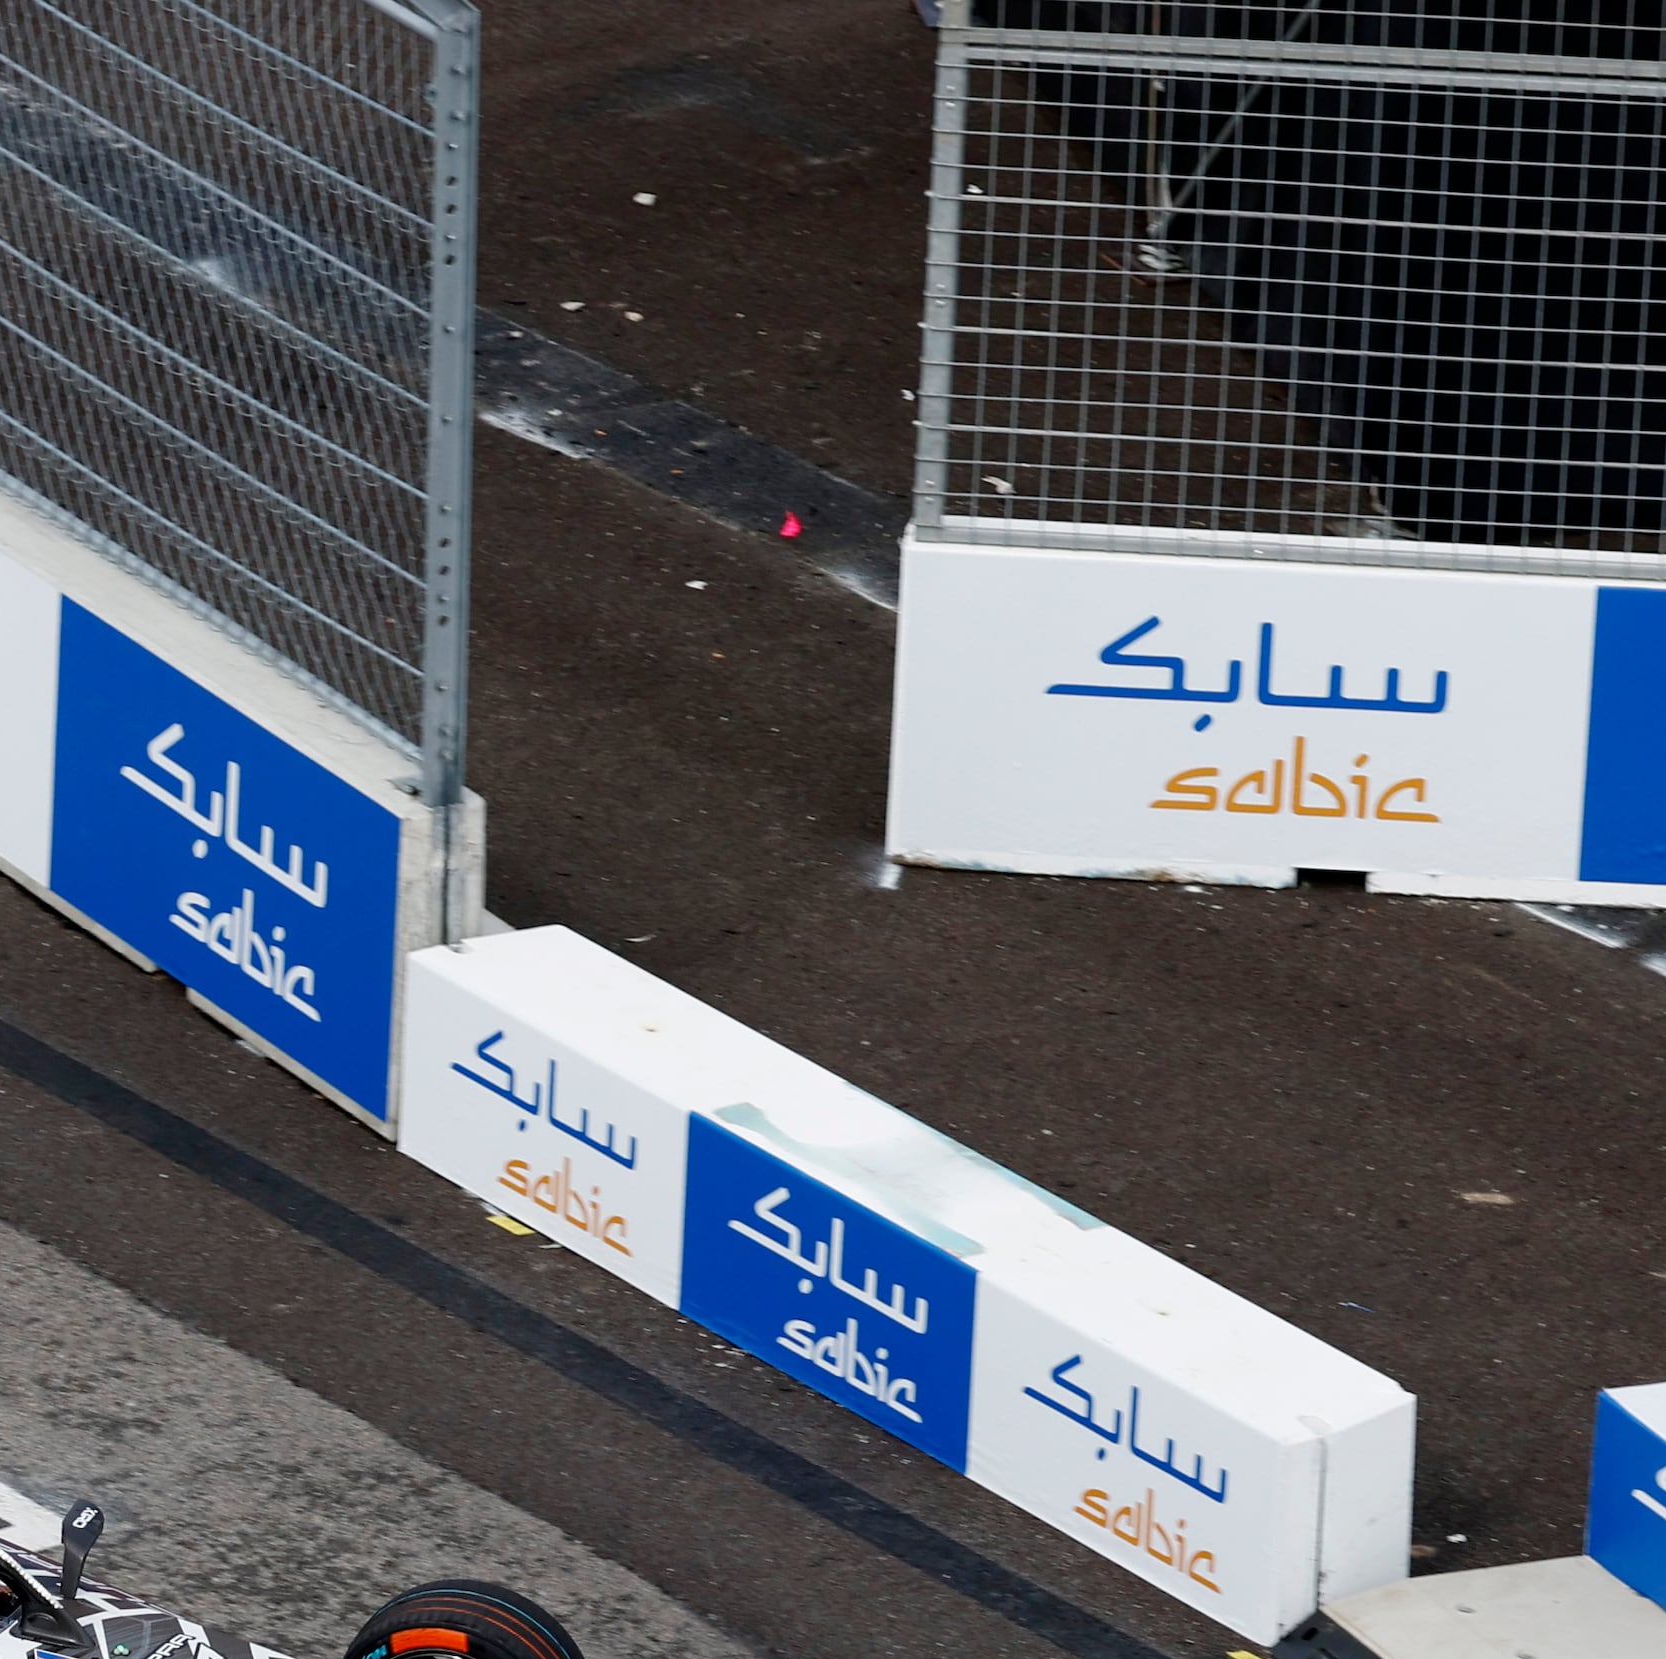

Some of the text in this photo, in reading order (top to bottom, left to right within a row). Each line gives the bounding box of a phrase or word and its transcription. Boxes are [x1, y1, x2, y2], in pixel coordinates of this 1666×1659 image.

[1046, 616, 1449, 732] سابك
[121, 723, 327, 908] سابك
[1151, 736, 1440, 823] sabic
[170, 889, 320, 1021] sabic
[451, 1031, 637, 1170] سابك
[497, 1157, 632, 1257] sabic
[728, 1187, 928, 1335] سابك
[776, 1318, 922, 1424] sabic
[1023, 1355, 1228, 1503] سابك
[1075, 1488, 1221, 1594] sabic
